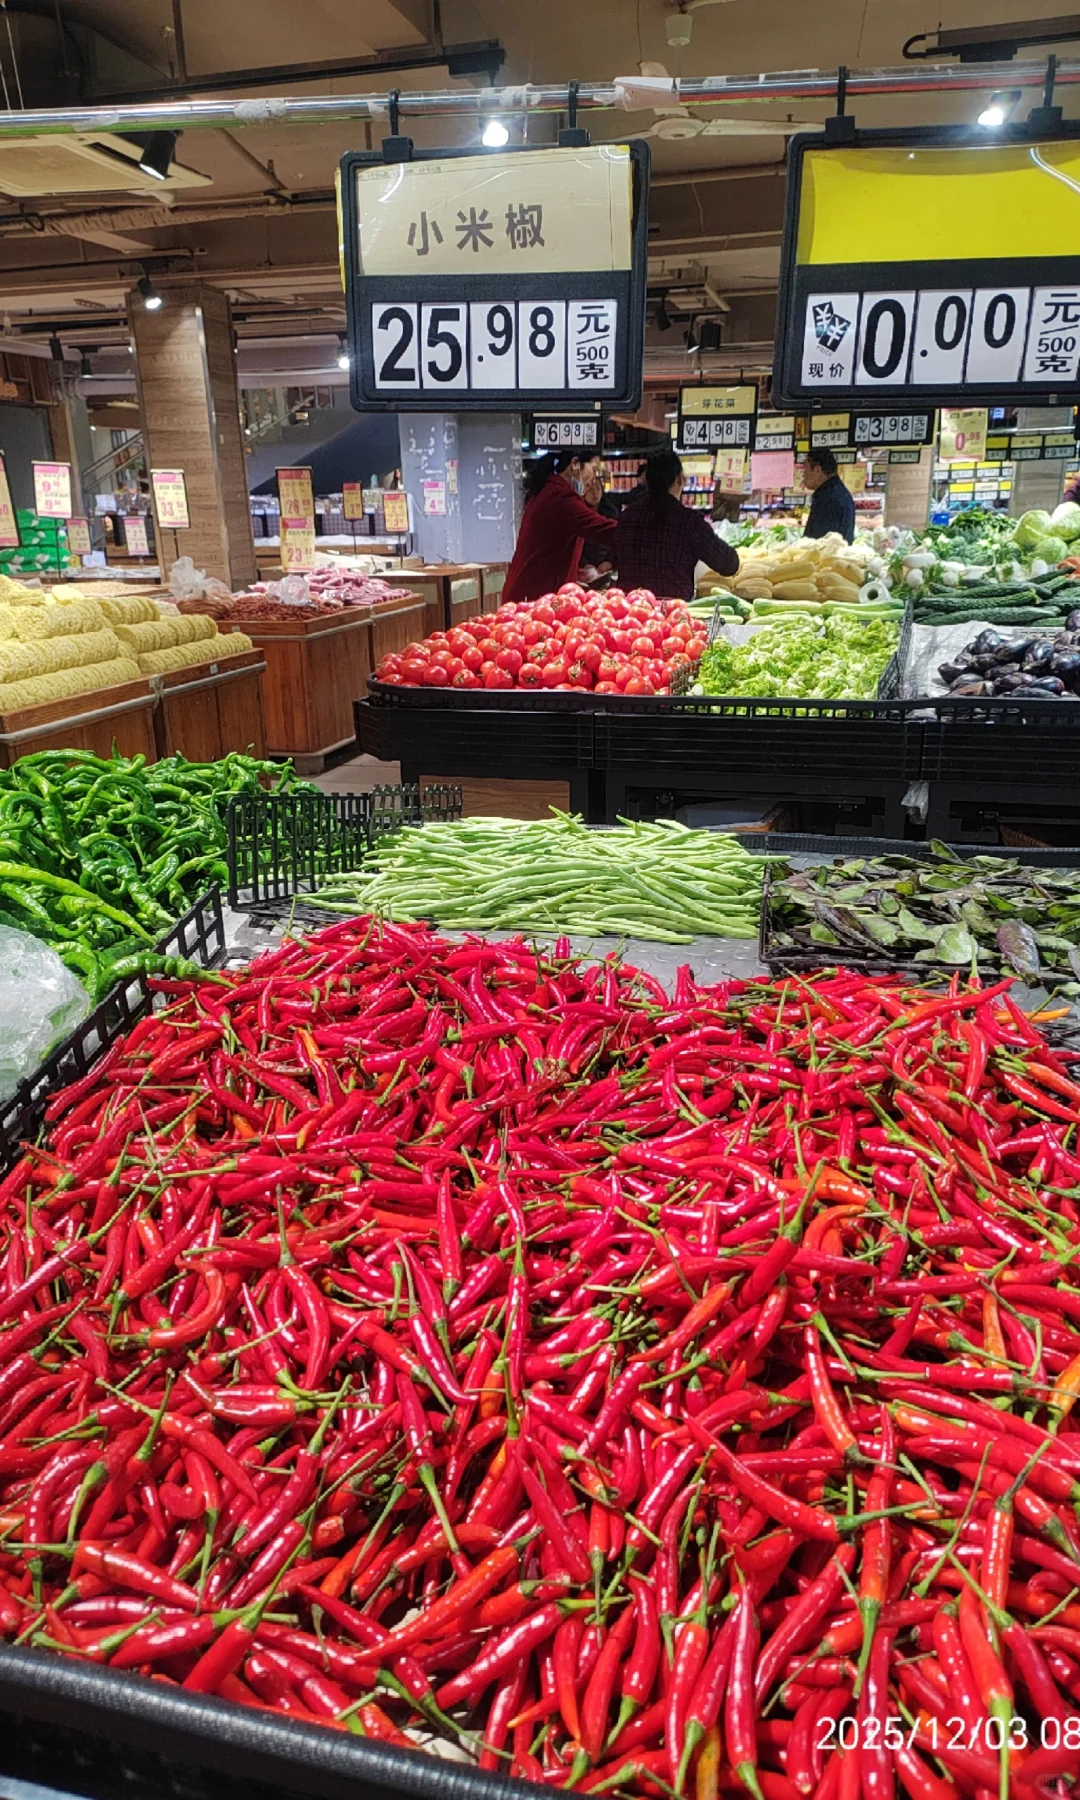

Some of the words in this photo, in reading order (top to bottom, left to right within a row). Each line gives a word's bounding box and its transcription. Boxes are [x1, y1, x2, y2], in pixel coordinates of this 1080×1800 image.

[407, 203, 545, 256] 小米椒
[377, 304, 556, 383] 25.98
[862, 293, 1017, 379] 0.00
[1037, 336, 1076, 353] 500
[576, 345, 609, 361] 500
[576, 362, 610, 381] 克
[808, 362, 845, 378] 现价
[1034, 354, 1074, 374] 克
[548, 424, 581, 442] 6.98
[697, 422, 733, 441] 4.98
[871, 418, 909, 437] 3.98
